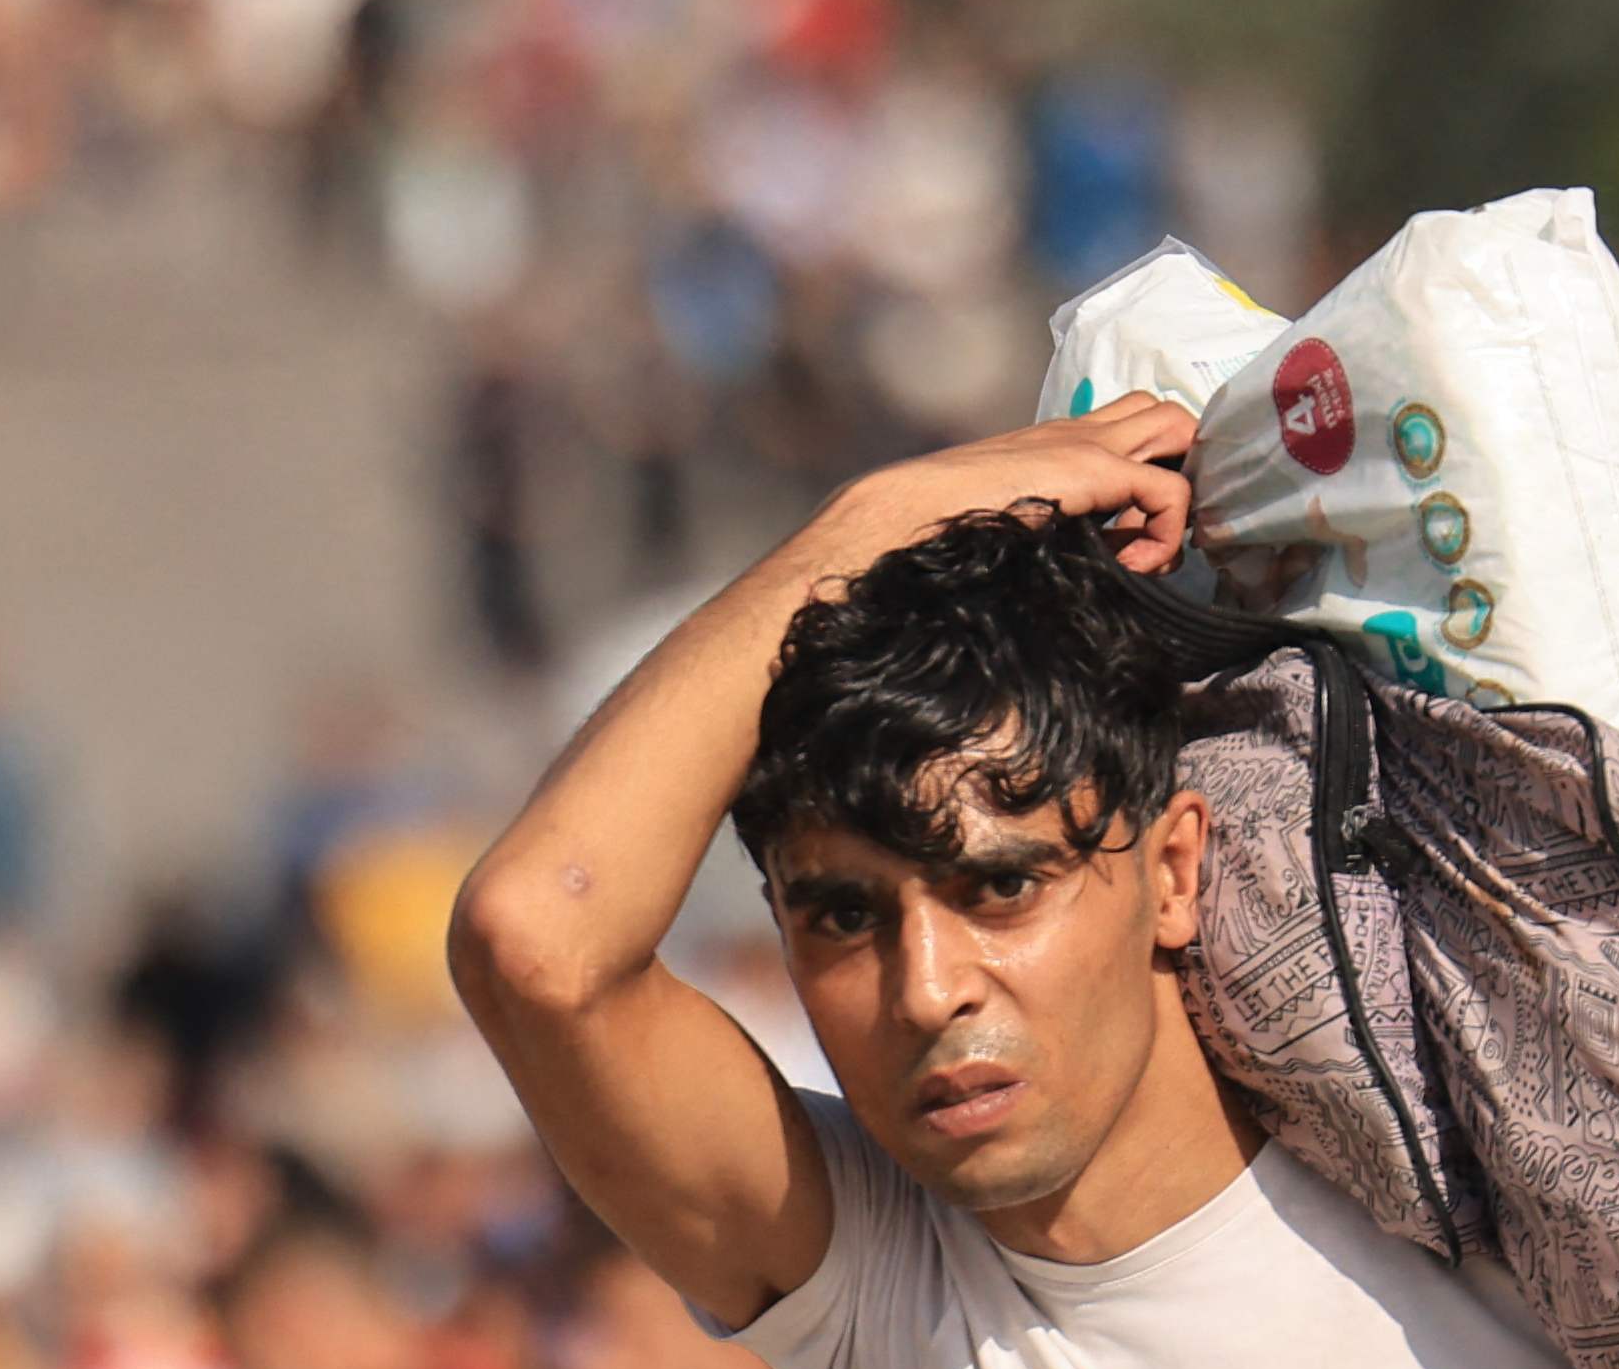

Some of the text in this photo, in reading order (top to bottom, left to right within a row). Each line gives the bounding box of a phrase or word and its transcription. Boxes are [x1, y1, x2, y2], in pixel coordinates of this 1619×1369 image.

[1285, 393, 1316, 435] 4
[1235, 957, 1317, 1021] LET THE
